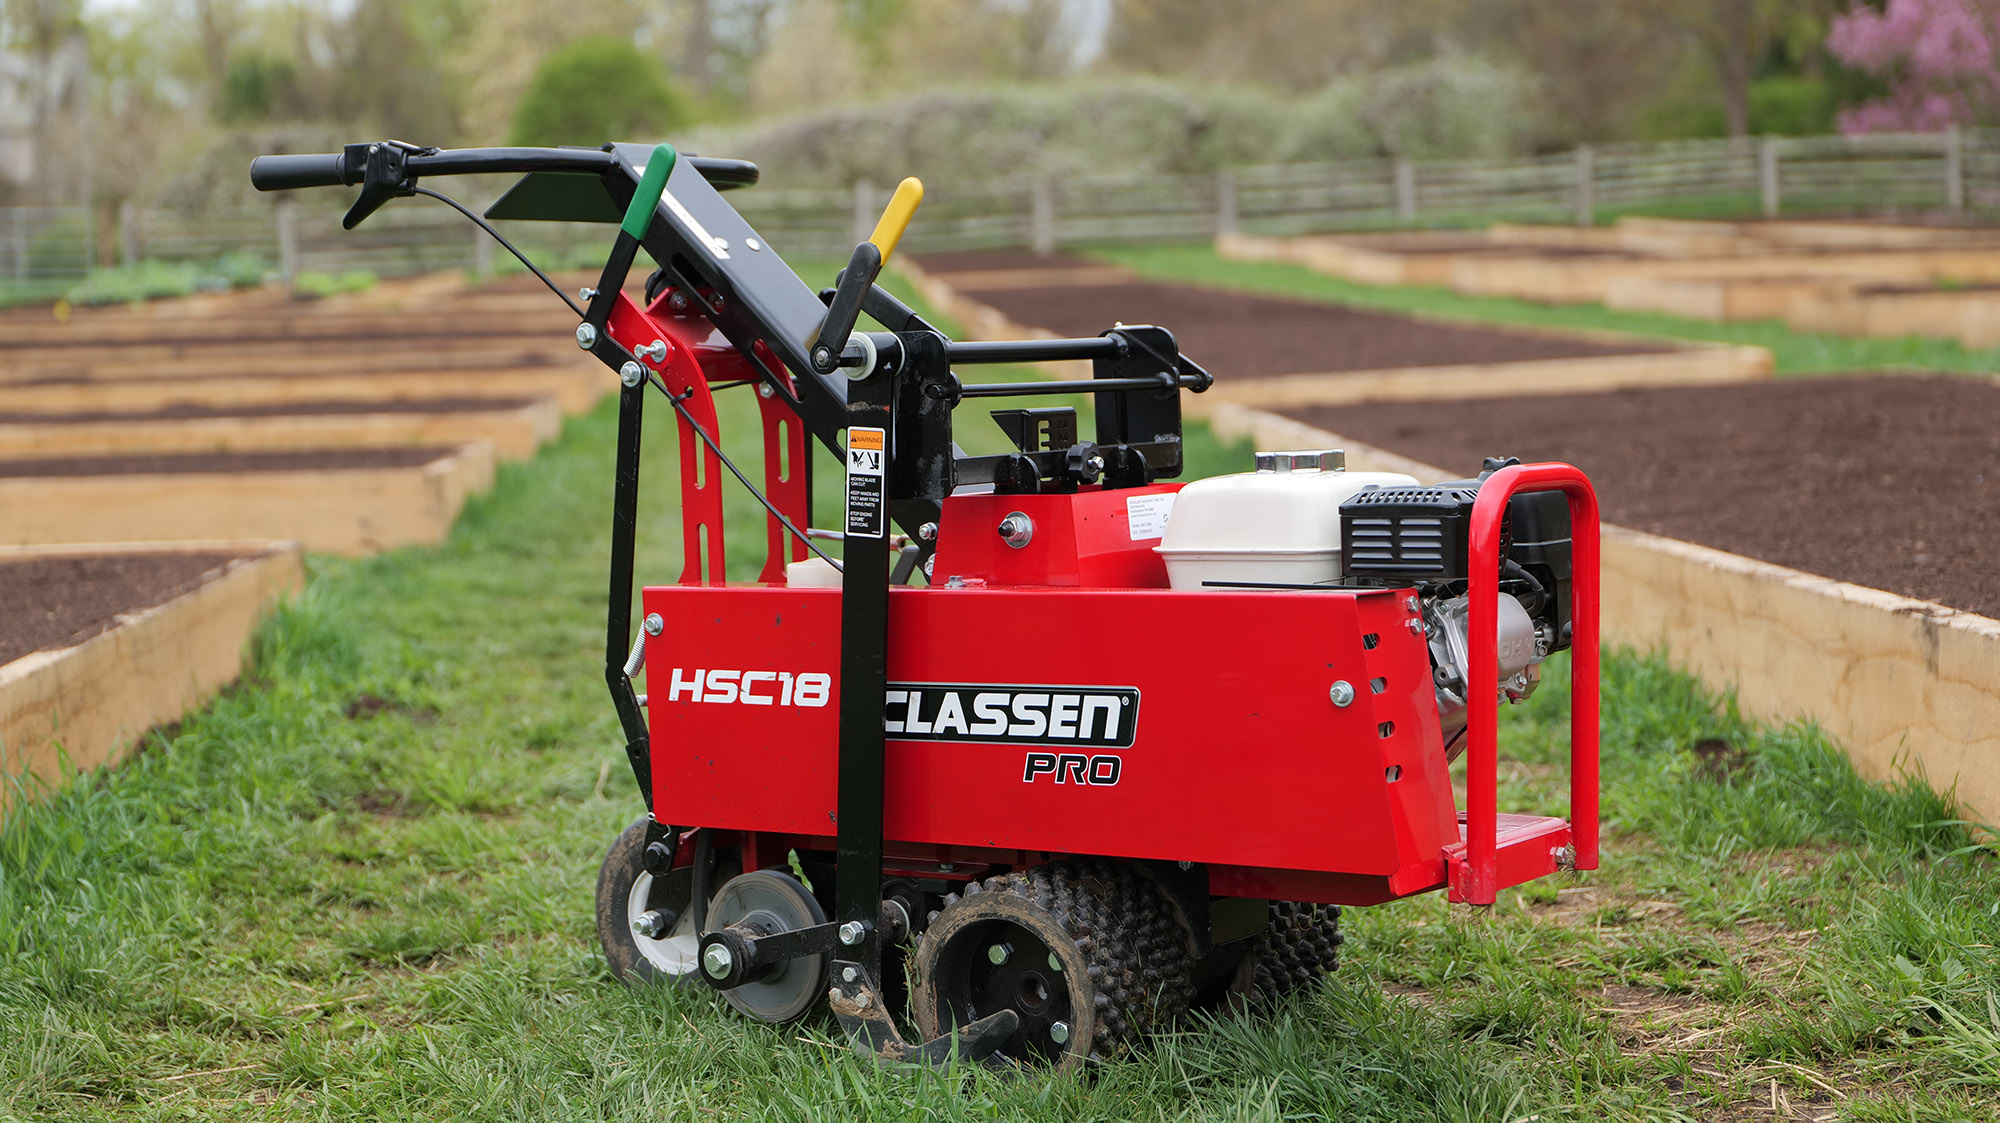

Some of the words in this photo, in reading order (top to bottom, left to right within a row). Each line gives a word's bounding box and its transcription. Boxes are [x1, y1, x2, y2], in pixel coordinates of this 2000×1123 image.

[857, 436, 881, 444] WARNING
[668, 668, 832, 707] HSC18
[885, 691, 1121, 740] CLASSEN
[1023, 752, 1122, 786] PRO
